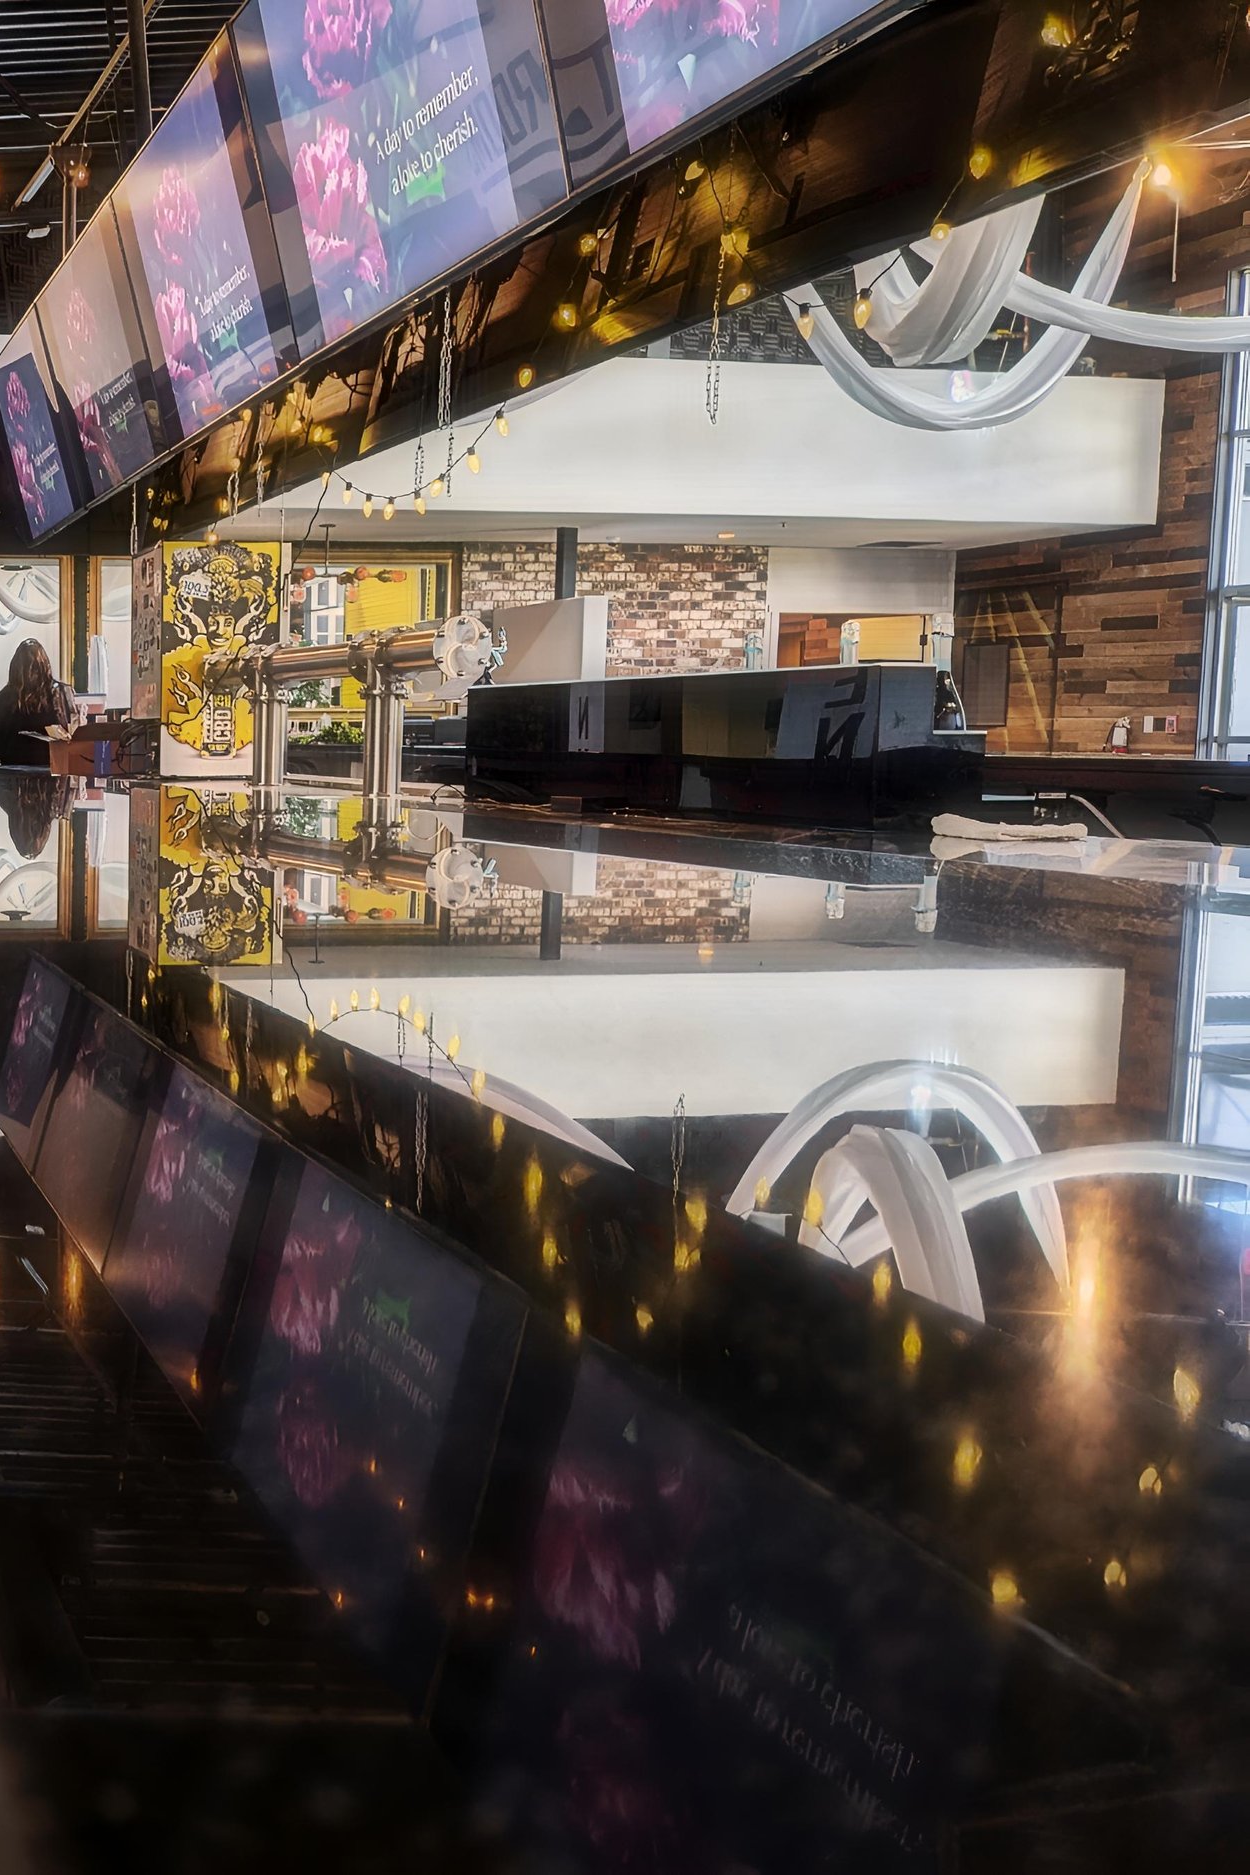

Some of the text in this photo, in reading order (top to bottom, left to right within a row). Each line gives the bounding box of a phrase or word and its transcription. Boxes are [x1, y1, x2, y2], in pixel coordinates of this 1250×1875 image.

[384, 128, 402, 156] day
[402, 118, 415, 141] to
[415, 65, 479, 131] remember,
[420, 141, 433, 173] to
[433, 109, 479, 161] cherish.
[213, 709, 232, 741] CBD
